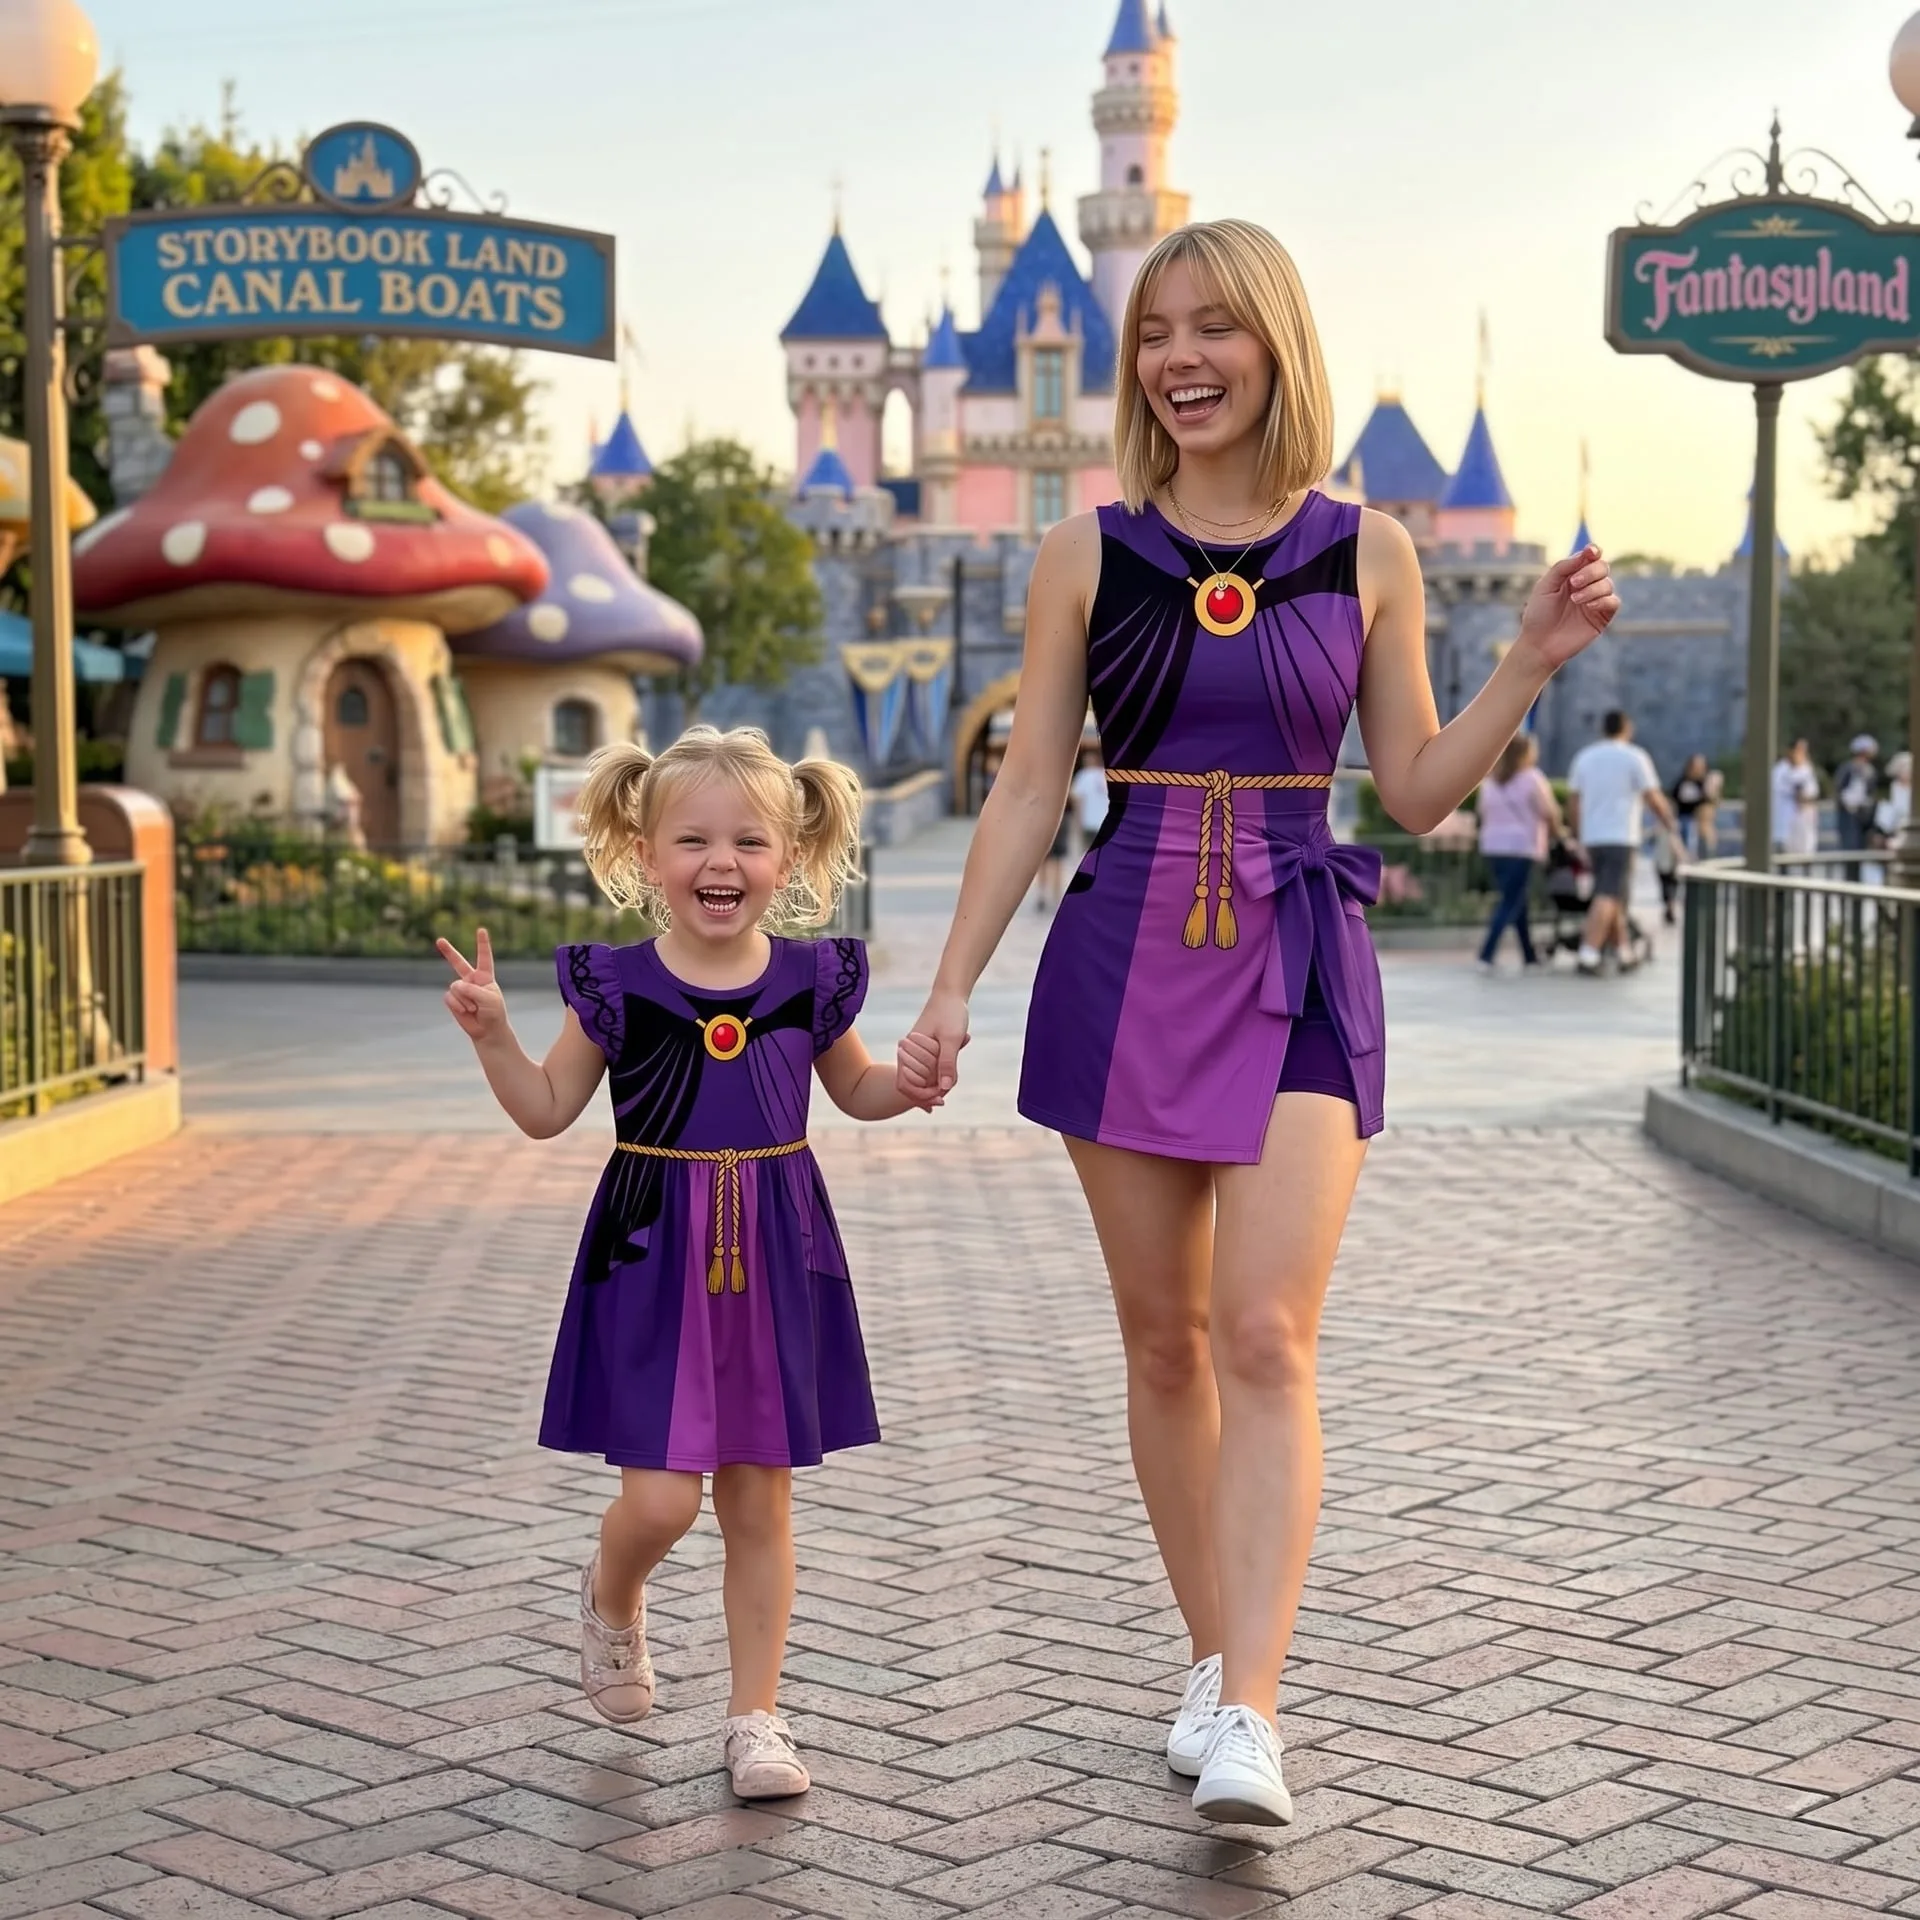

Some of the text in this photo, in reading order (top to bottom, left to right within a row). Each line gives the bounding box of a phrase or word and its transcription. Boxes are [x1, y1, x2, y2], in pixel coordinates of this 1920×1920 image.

[158, 227, 567, 279] STORYBOOK LAND
[163, 270, 565, 330] CANAL BOATS
[1635, 247, 1910, 331] Fantasyland
